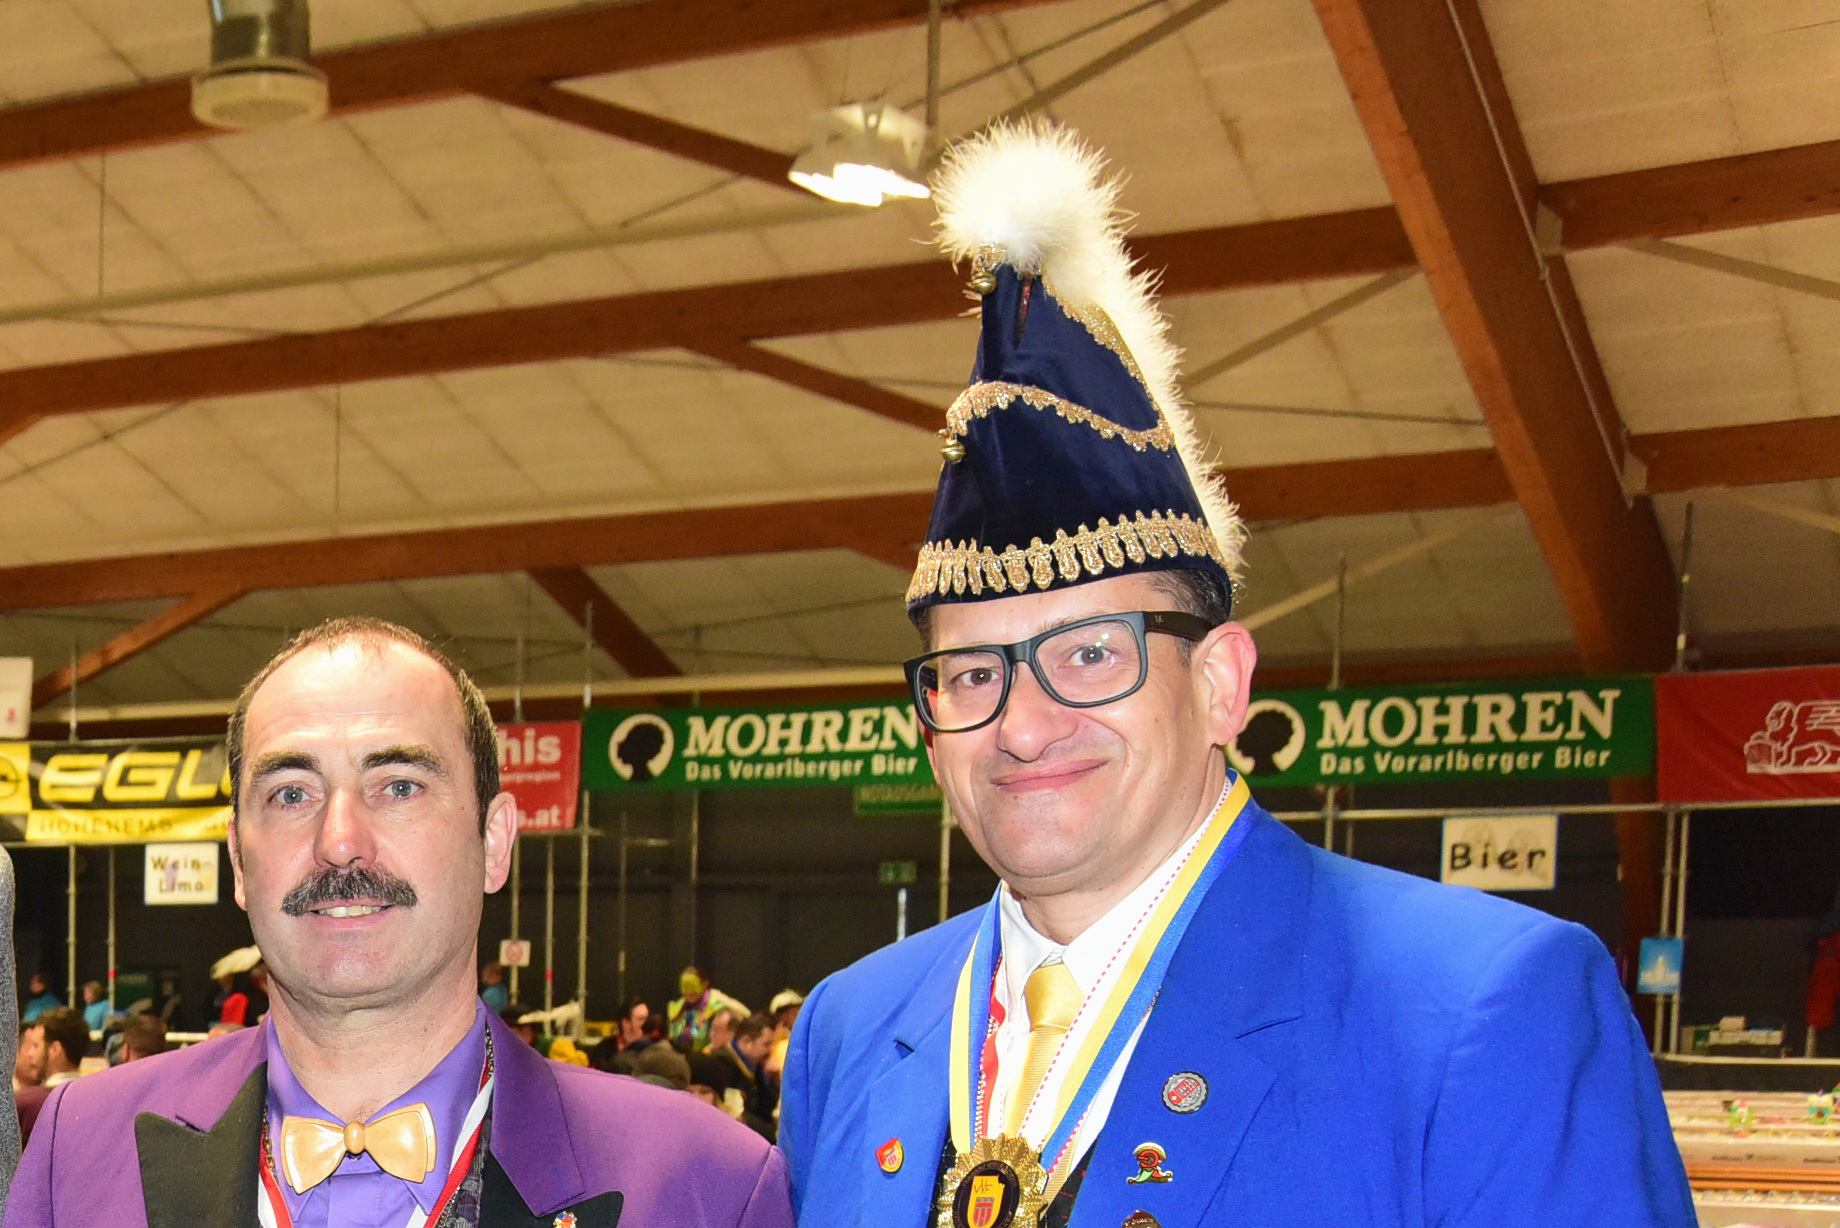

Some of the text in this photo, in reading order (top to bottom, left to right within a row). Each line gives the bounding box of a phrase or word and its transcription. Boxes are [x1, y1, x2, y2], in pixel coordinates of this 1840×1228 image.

[682, 703, 918, 757] MOHREN
[1316, 689, 1621, 749] MOHREN
[685, 753, 918, 781] Das Vorarlberger Bier
[1320, 746, 1611, 775] Das Vorarlberger Bier
[1450, 843, 1546, 870] Bier
